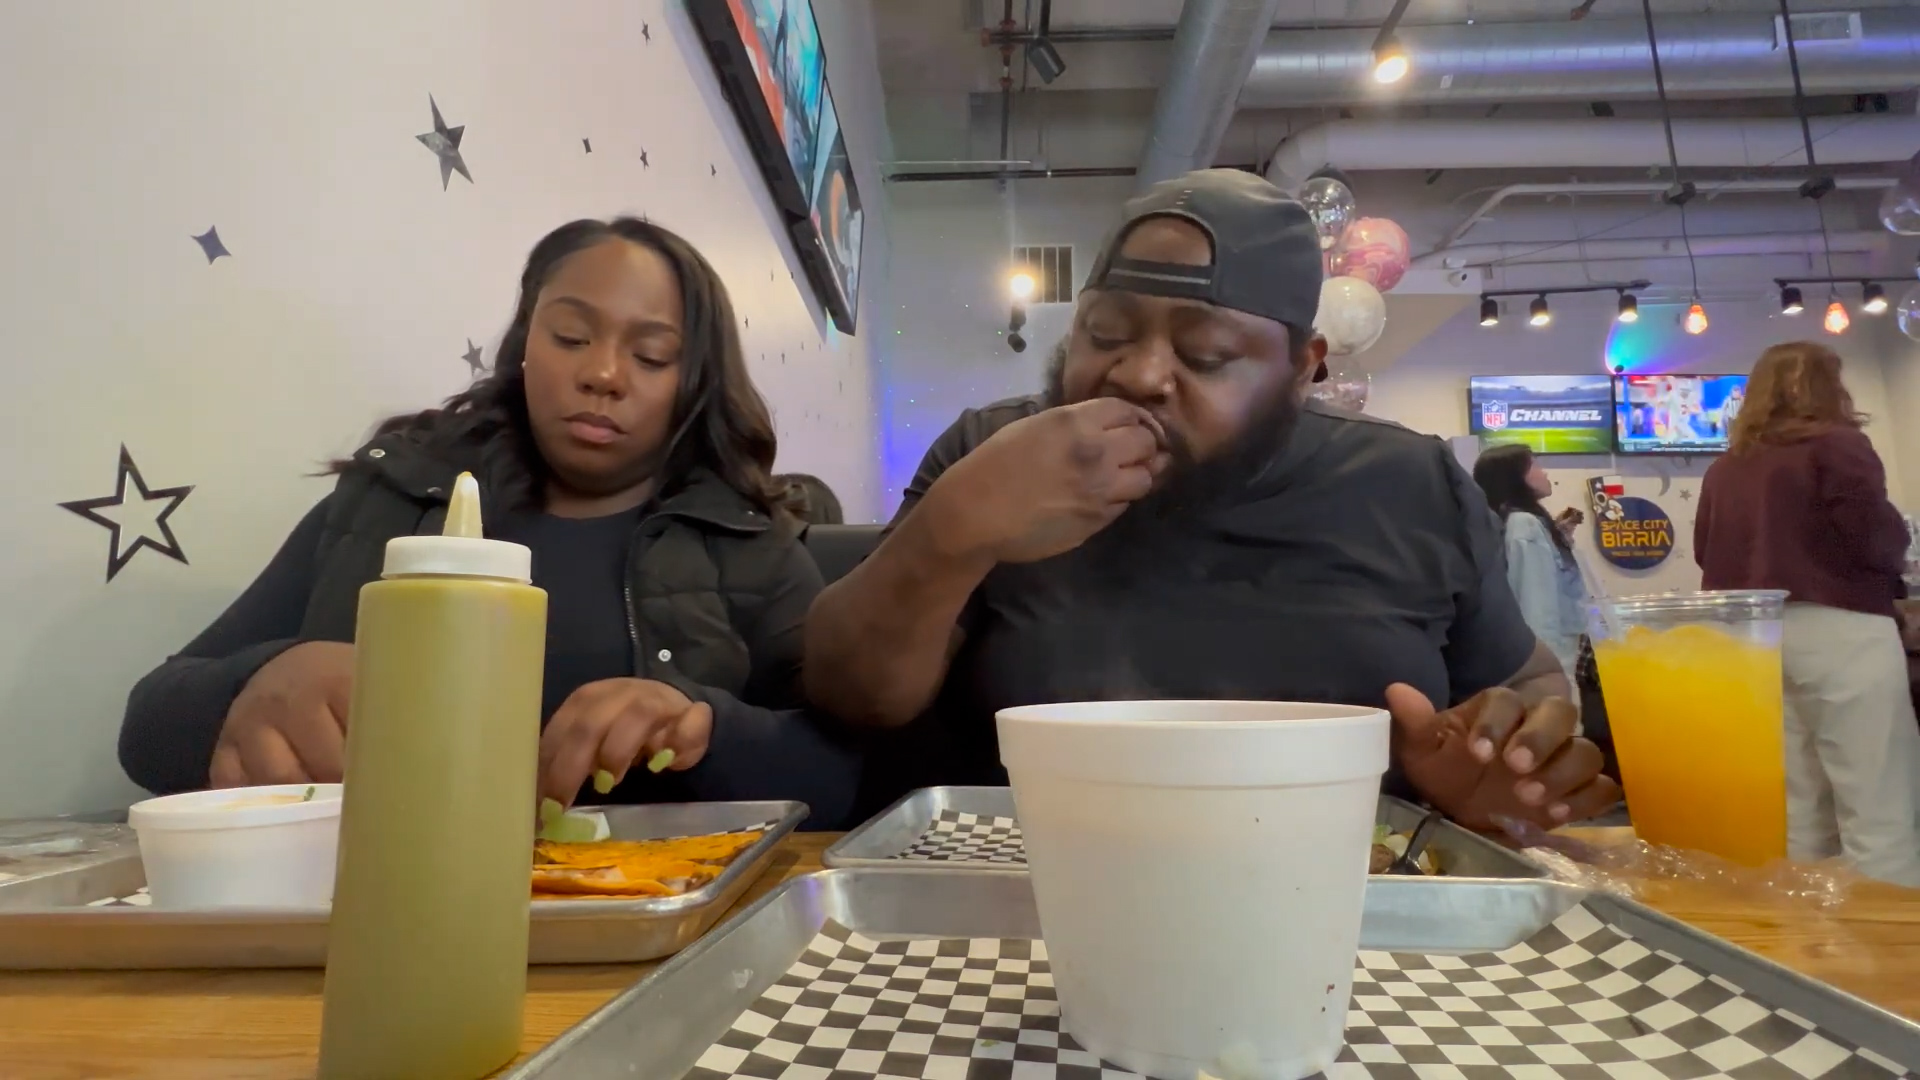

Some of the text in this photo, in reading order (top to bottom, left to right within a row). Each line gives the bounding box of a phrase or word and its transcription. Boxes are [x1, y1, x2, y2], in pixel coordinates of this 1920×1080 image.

[1486, 409, 1602, 427] NFL CHANNEL
[1601, 520, 1668, 531] SPACE CITY
[1602, 531, 1671, 547] BIRRIA
